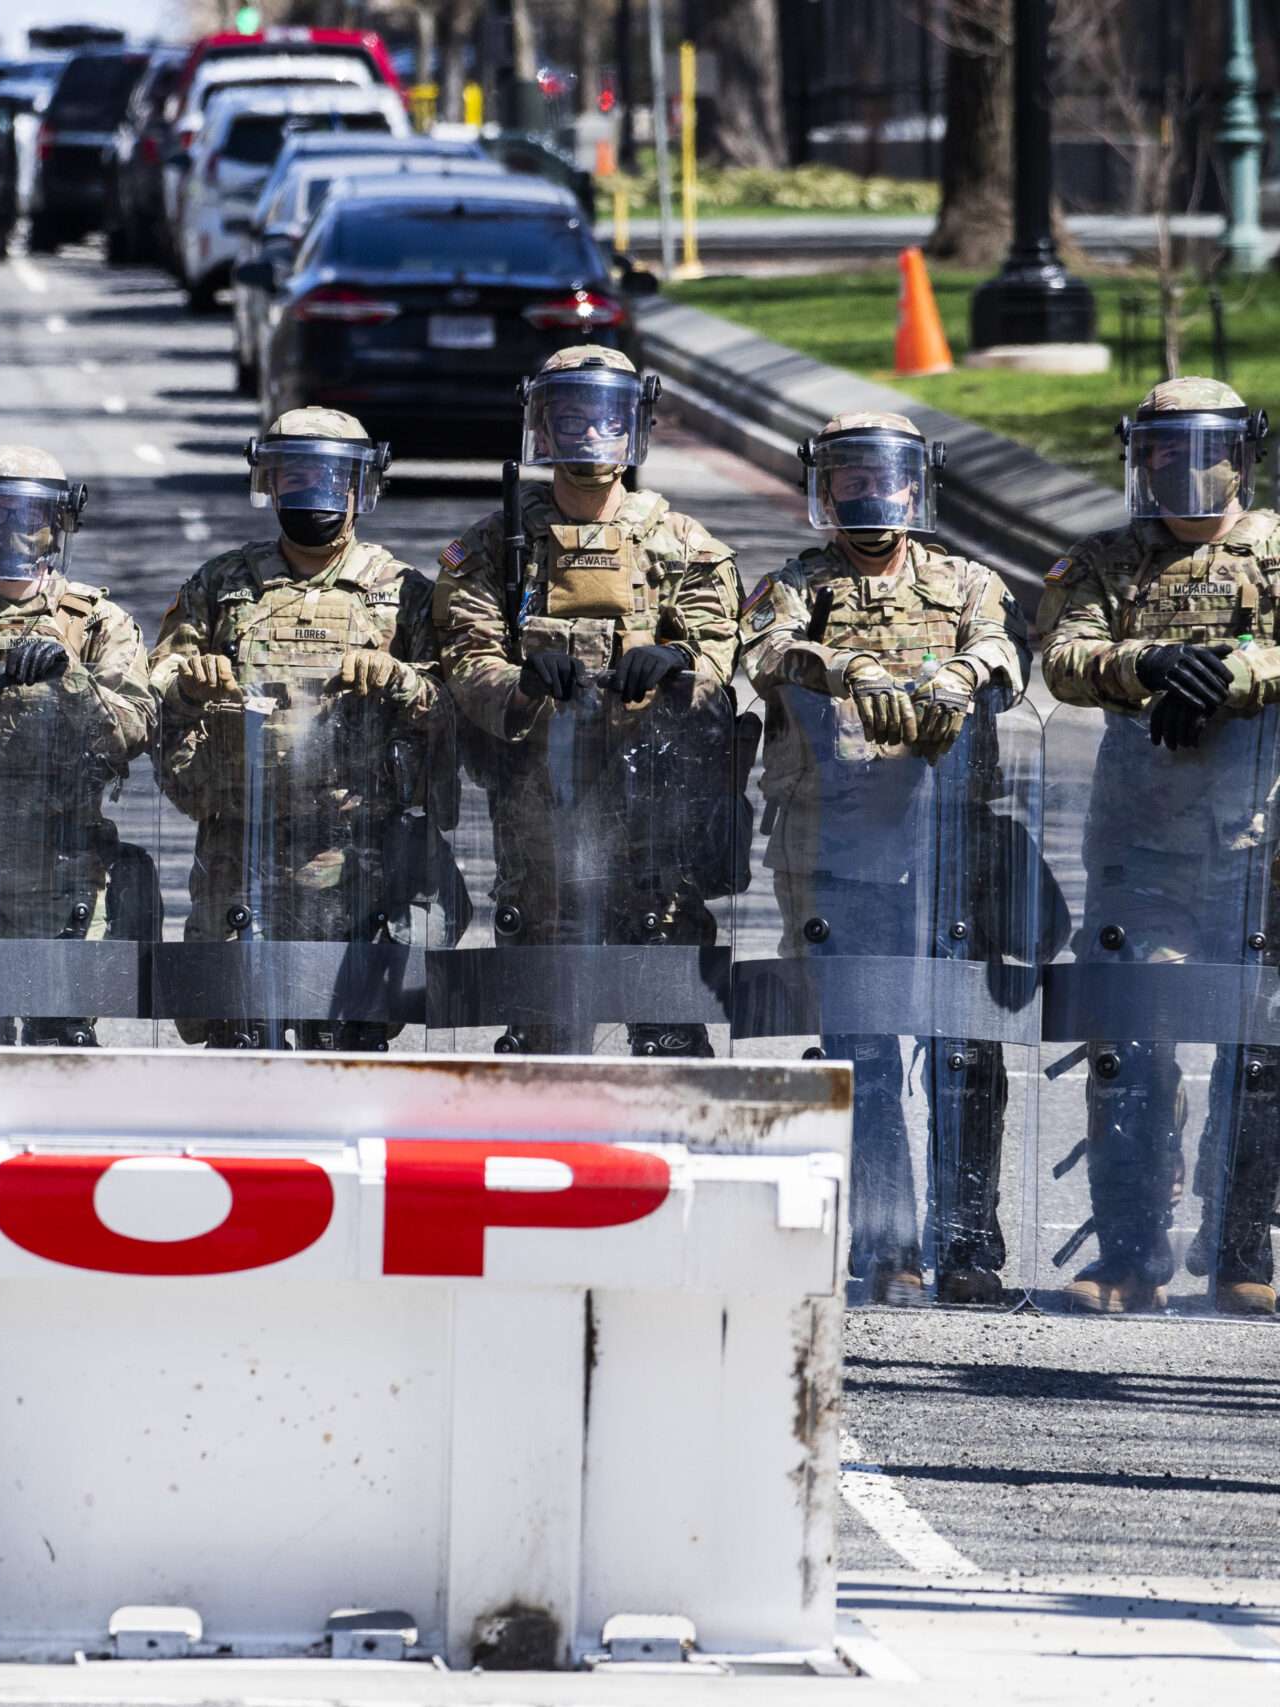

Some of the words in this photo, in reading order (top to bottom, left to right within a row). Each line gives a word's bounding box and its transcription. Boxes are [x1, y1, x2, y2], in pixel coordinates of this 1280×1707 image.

[564, 555, 615, 567] STEWART
[1174, 583, 1232, 595] MCFARLAND
[365, 591, 393, 603] ARMY
[295, 629, 327, 640] FLORES
